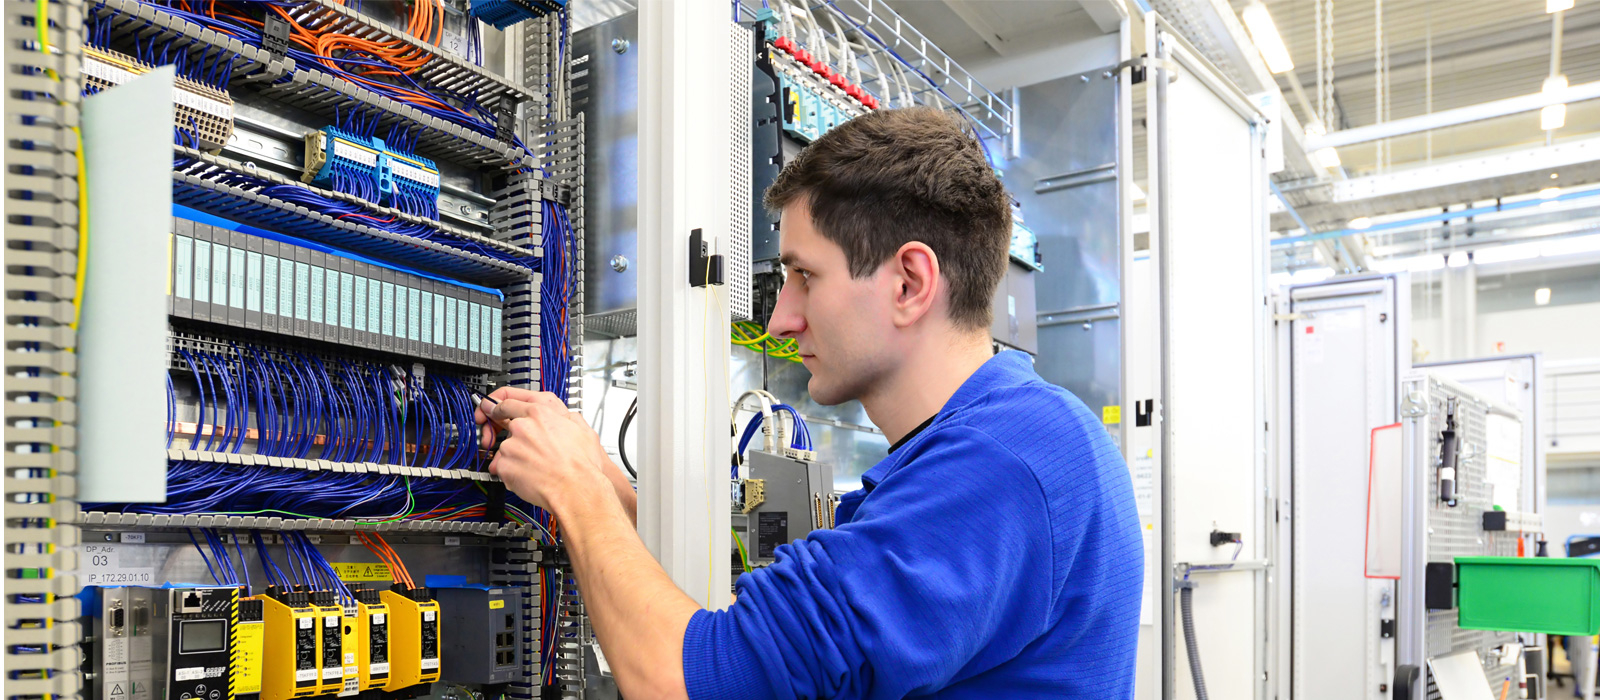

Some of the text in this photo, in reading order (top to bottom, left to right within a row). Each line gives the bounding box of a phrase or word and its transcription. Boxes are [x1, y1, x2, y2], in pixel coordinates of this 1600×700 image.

[450, 40, 459, 52] 12
[92, 555, 108, 567] 03
[88, 572, 150, 584] IP_172.29.01.10
